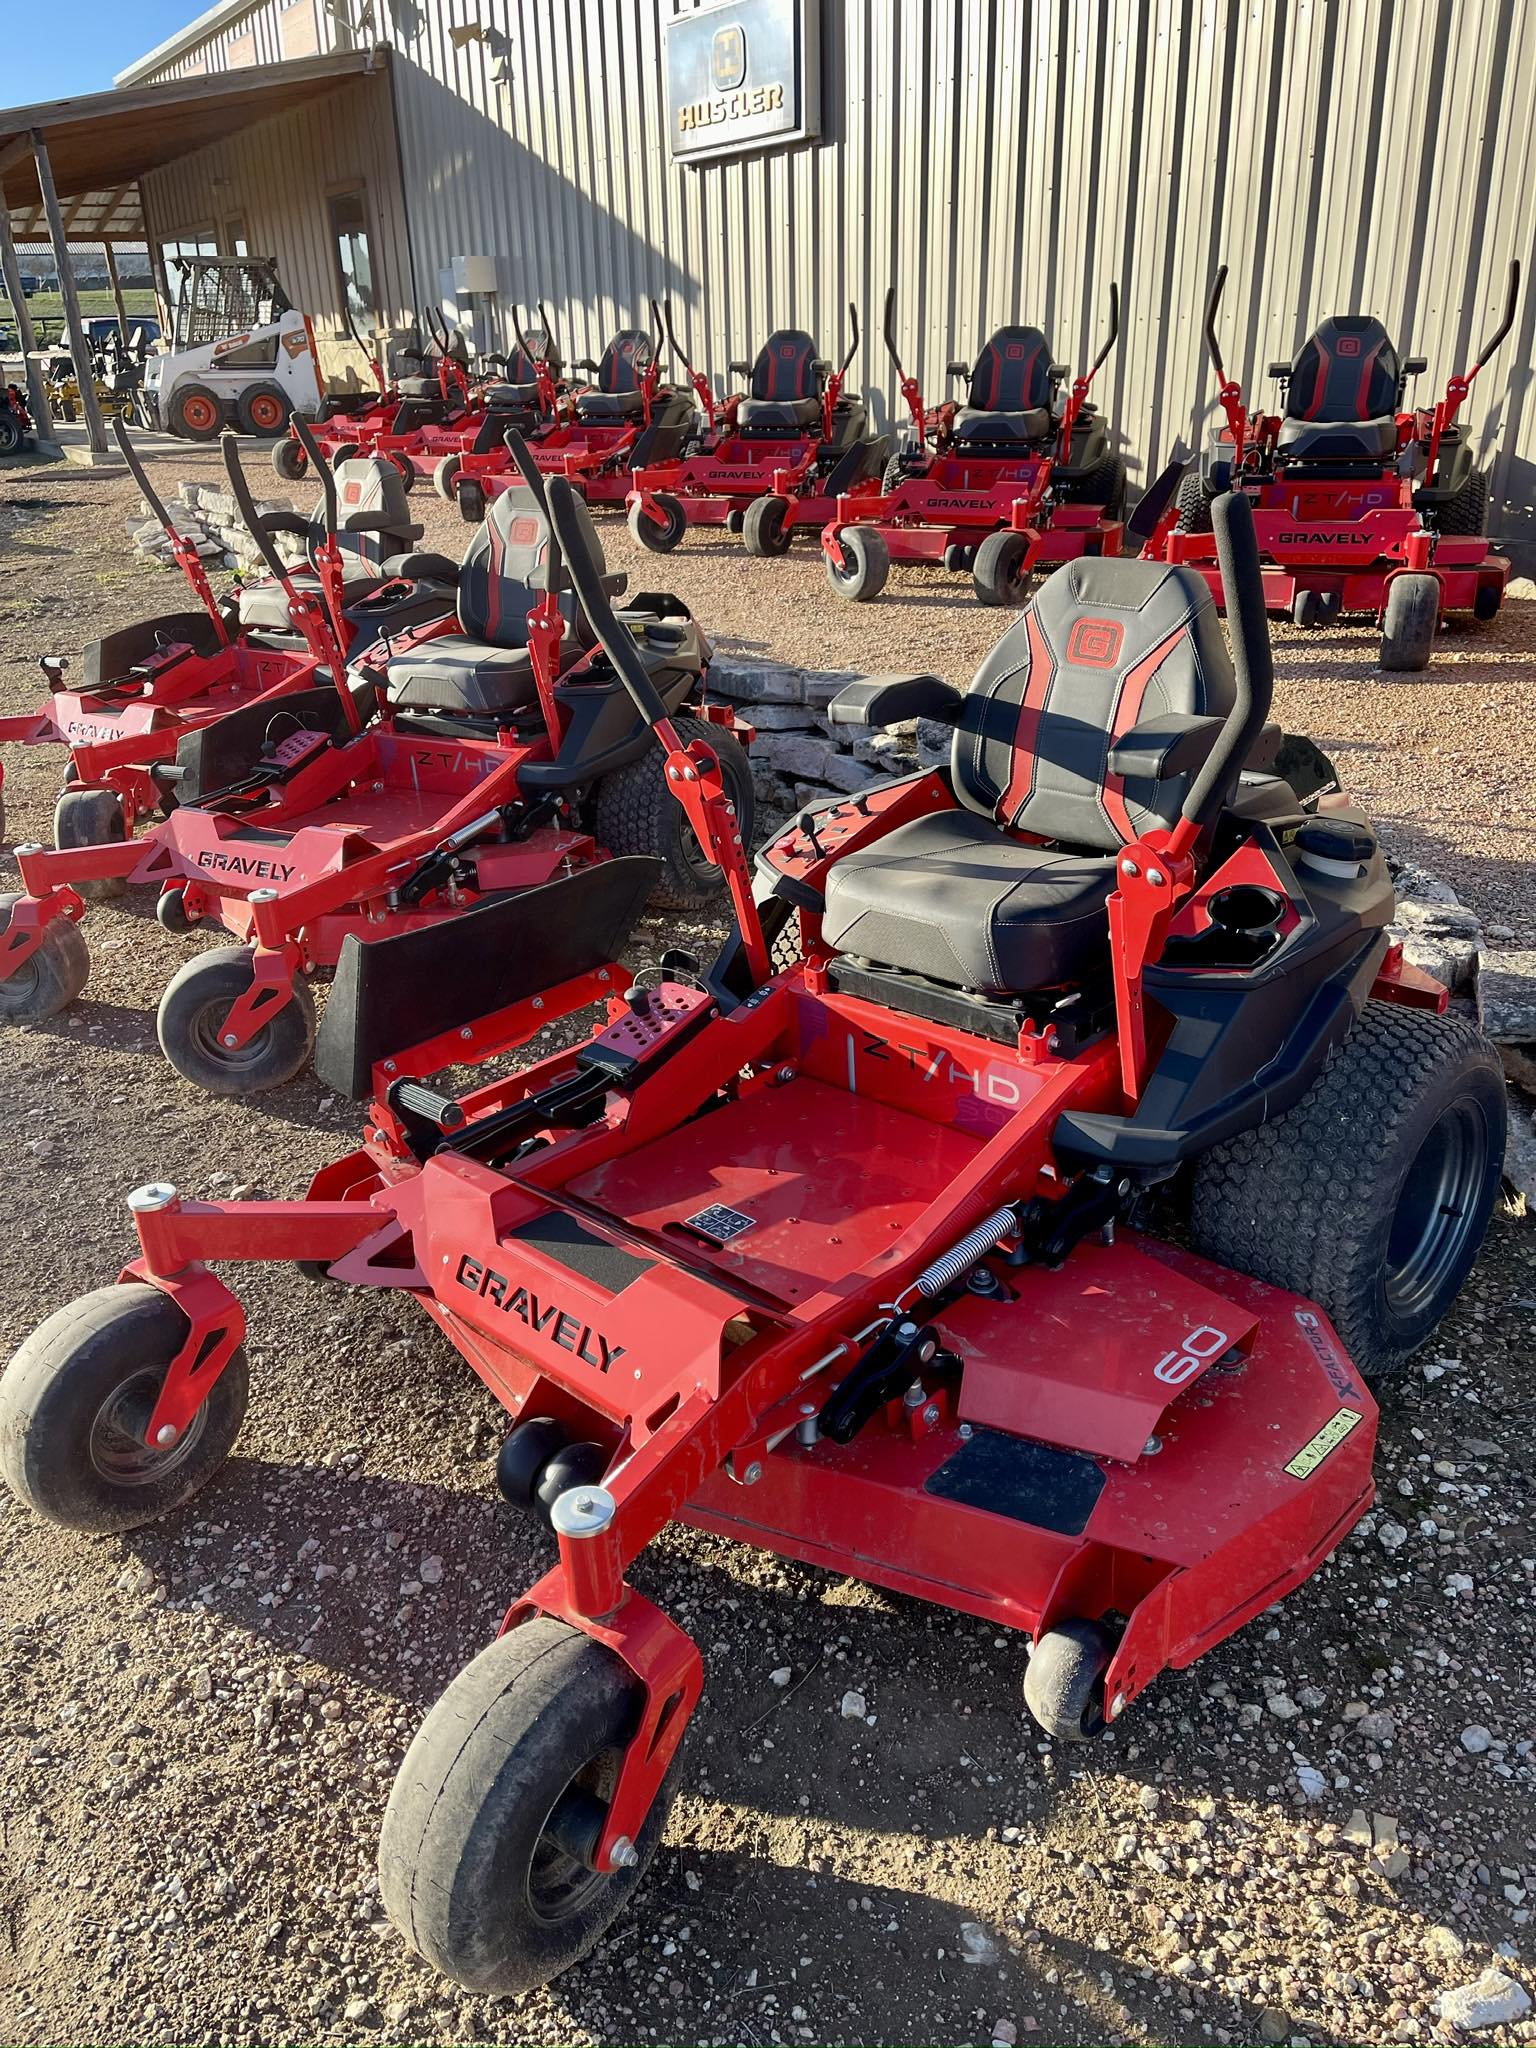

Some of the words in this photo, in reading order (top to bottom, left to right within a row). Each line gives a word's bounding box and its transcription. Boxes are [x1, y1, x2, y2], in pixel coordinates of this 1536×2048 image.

[678, 82, 783, 131] HUSTLER
[533, 454, 566, 462] RAVEL
[709, 471, 765, 479] GRAVELY
[927, 498, 996, 509] GRAVELY
[1303, 491, 1383, 507] ZT/HD
[1278, 533, 1375, 544] GRAVELY
[196, 851, 297, 883] GRAVELY
[863, 1031, 1020, 1105] ZT/HD
[455, 1254, 626, 1374] GRAVELY
[1154, 1326, 1228, 1385] 60
